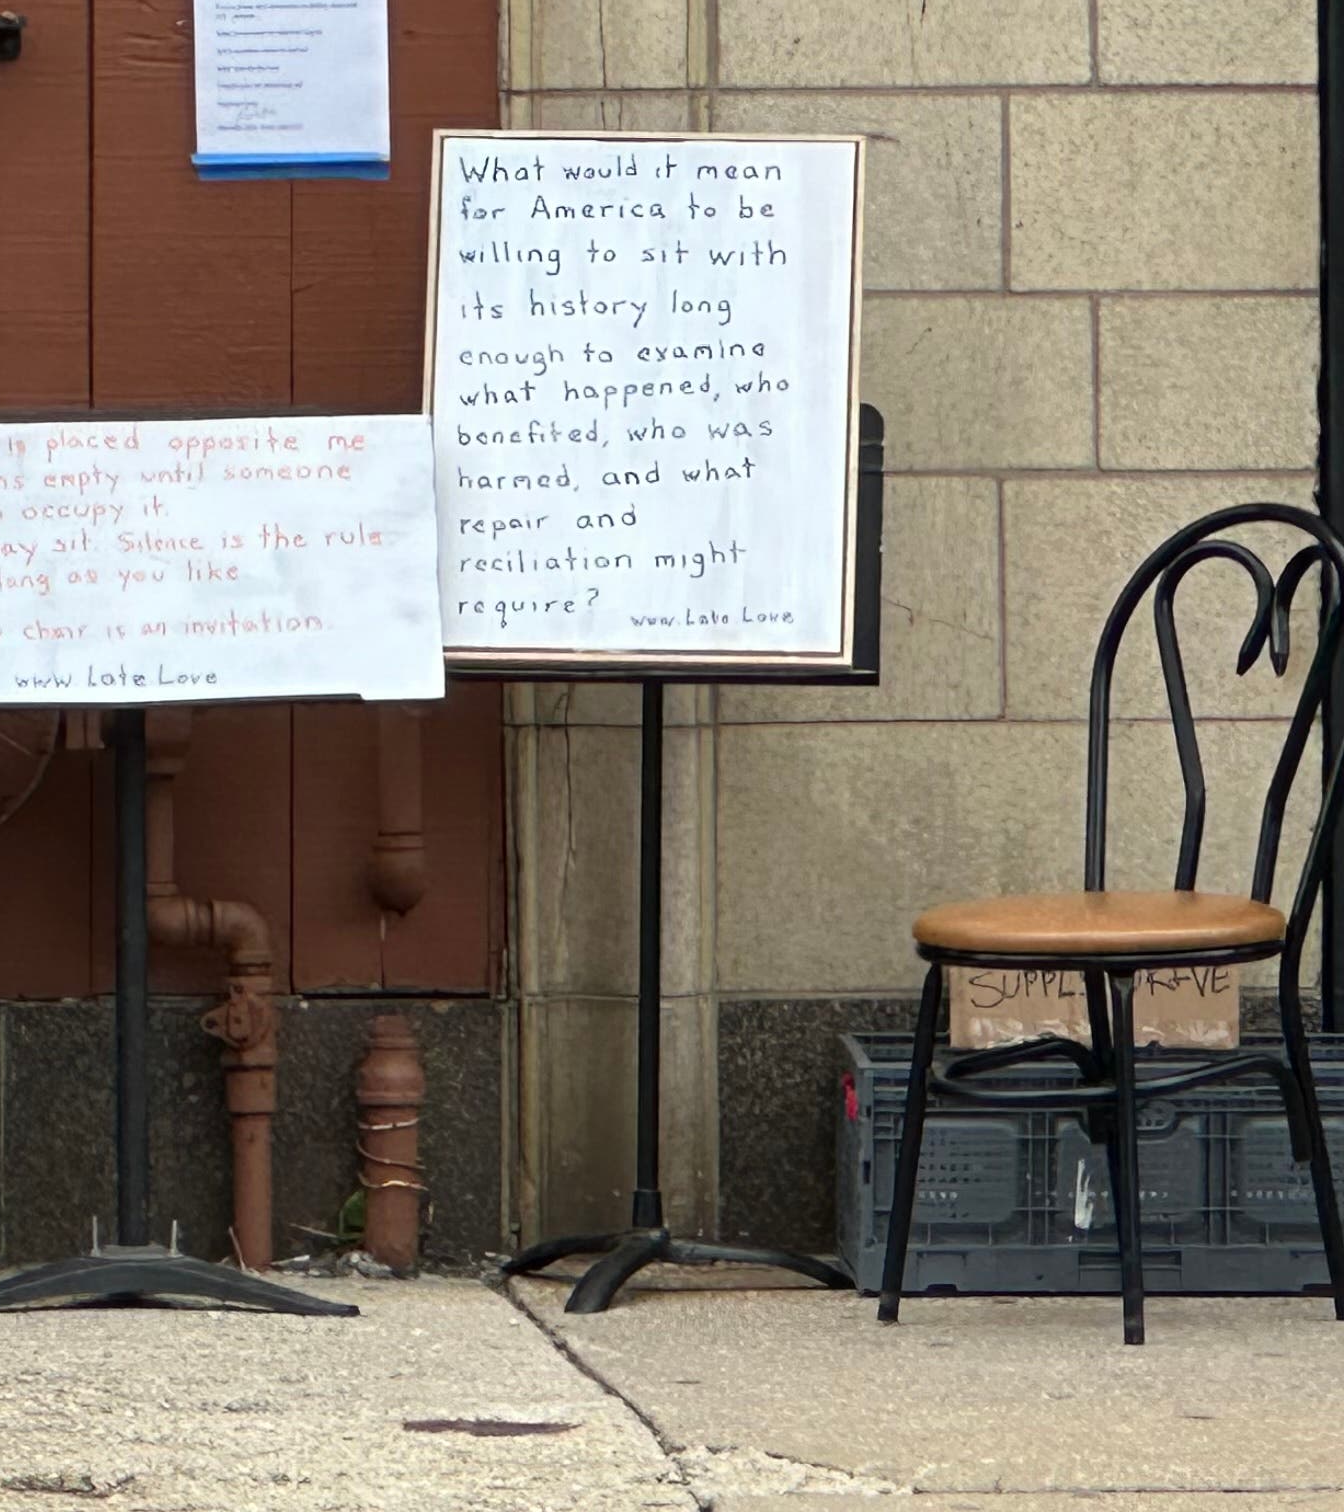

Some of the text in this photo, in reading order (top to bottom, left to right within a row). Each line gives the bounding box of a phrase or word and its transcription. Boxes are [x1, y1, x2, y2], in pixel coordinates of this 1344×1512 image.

[459, 154, 782, 183] What would it mean
[460, 192, 775, 221] for America to be
[459, 240, 787, 276] willing to sit with
[461, 289, 732, 328] its history long
[459, 340, 765, 376] enough to examine
[459, 371, 790, 410] what happened, who
[9, 435, 26, 455] is
[47, 426, 140, 463] placed
[169, 426, 299, 460] opposite
[328, 434, 368, 451] me
[458, 417, 773, 448] benefited, who was
[44, 464, 119, 495] empty
[141, 461, 204, 483] until
[223, 464, 352, 481] someone
[458, 457, 756, 492] harmed, and what
[22, 503, 124, 527] occupy
[459, 503, 637, 540] repair and
[118, 531, 204, 552] Silence
[222, 532, 244, 549] is
[259, 523, 307, 551] the
[68, 570, 98, 584] as
[119, 568, 165, 591] you
[187, 560, 239, 582] like
[460, 540, 747, 578] reciliation might
[459, 588, 599, 629] require?
[23, 620, 88, 641] chair
[107, 624, 126, 640] is
[141, 621, 167, 637] an
